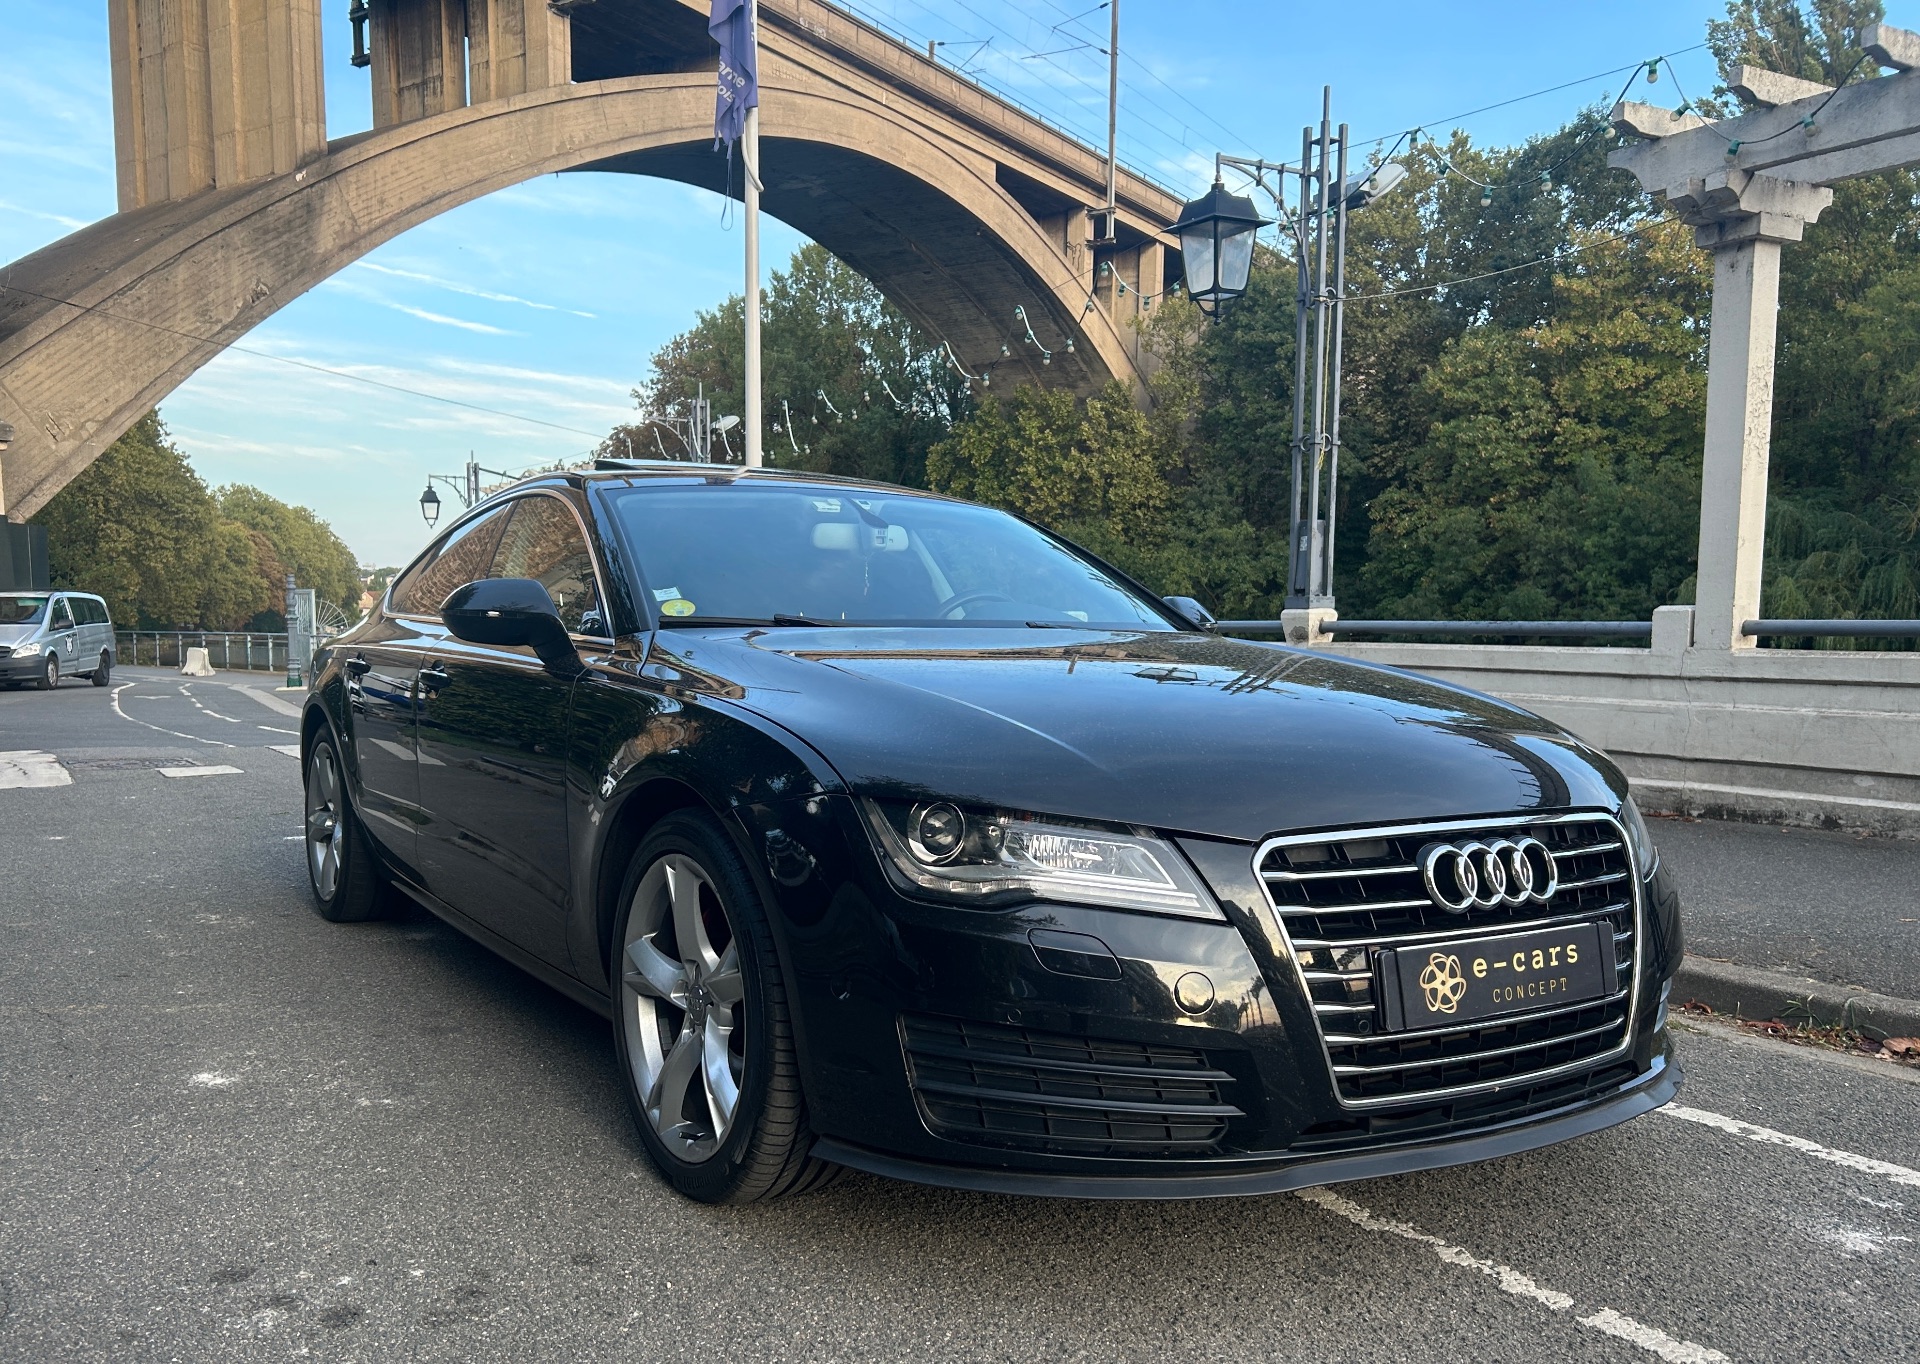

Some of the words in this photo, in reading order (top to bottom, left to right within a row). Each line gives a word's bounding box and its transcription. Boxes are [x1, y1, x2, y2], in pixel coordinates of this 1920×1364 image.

[719, 57, 745, 88] arne
[717, 79, 736, 102] ois
[1472, 943, 1579, 978] e-cars
[1492, 977, 1568, 1003] CONCEPT
